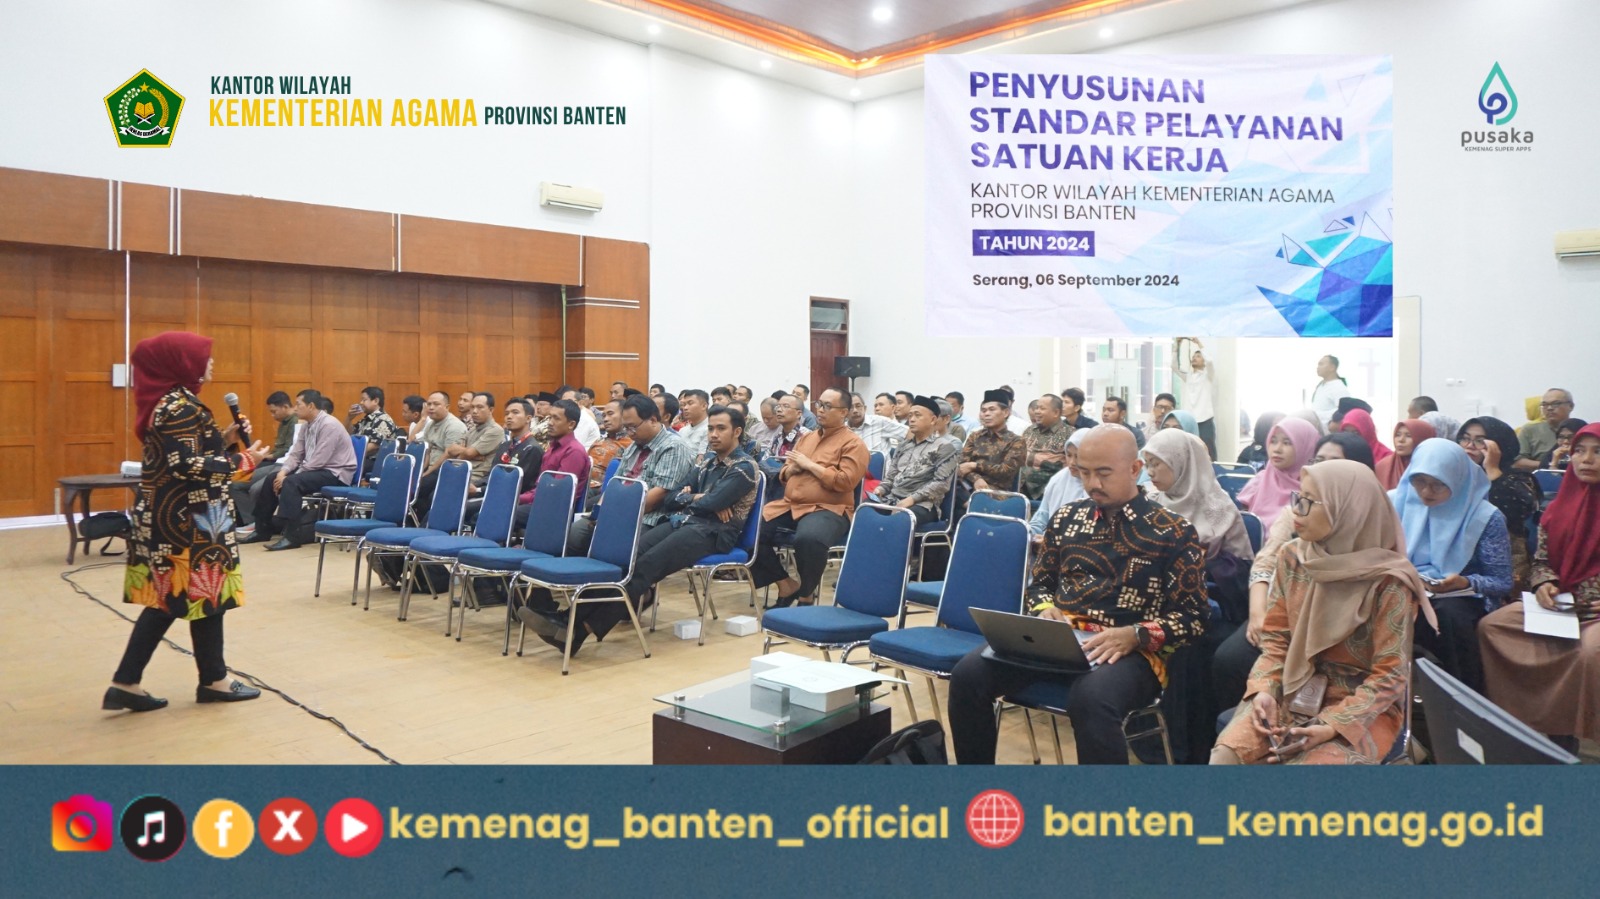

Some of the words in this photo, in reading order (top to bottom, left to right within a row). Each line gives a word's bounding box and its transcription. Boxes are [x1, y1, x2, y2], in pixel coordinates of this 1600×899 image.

[969, 71, 1205, 104] PENYUSUNAN
[969, 106, 1137, 137] STANDAR
[1144, 111, 1344, 142] PELAYANAN
[970, 142, 1114, 171] SATUAN
[1123, 146, 1230, 173] KERJA
[970, 182, 1048, 200] KANTOR
[1053, 184, 1137, 201] WILAYAH
[1142, 185, 1263, 203] KEMENTERIAN
[1268, 188, 1336, 204] AGAMA
[971, 203, 1058, 219] PROVINSI
[1063, 204, 1136, 220] BANTEN
[979, 235, 1043, 251] TAHUN
[1046, 236, 1090, 251] 2024
[972, 273, 1033, 290] Serang,
[1035, 273, 1055, 286] 06
[1057, 273, 1141, 290] September
[1144, 274, 1180, 287] 2024
